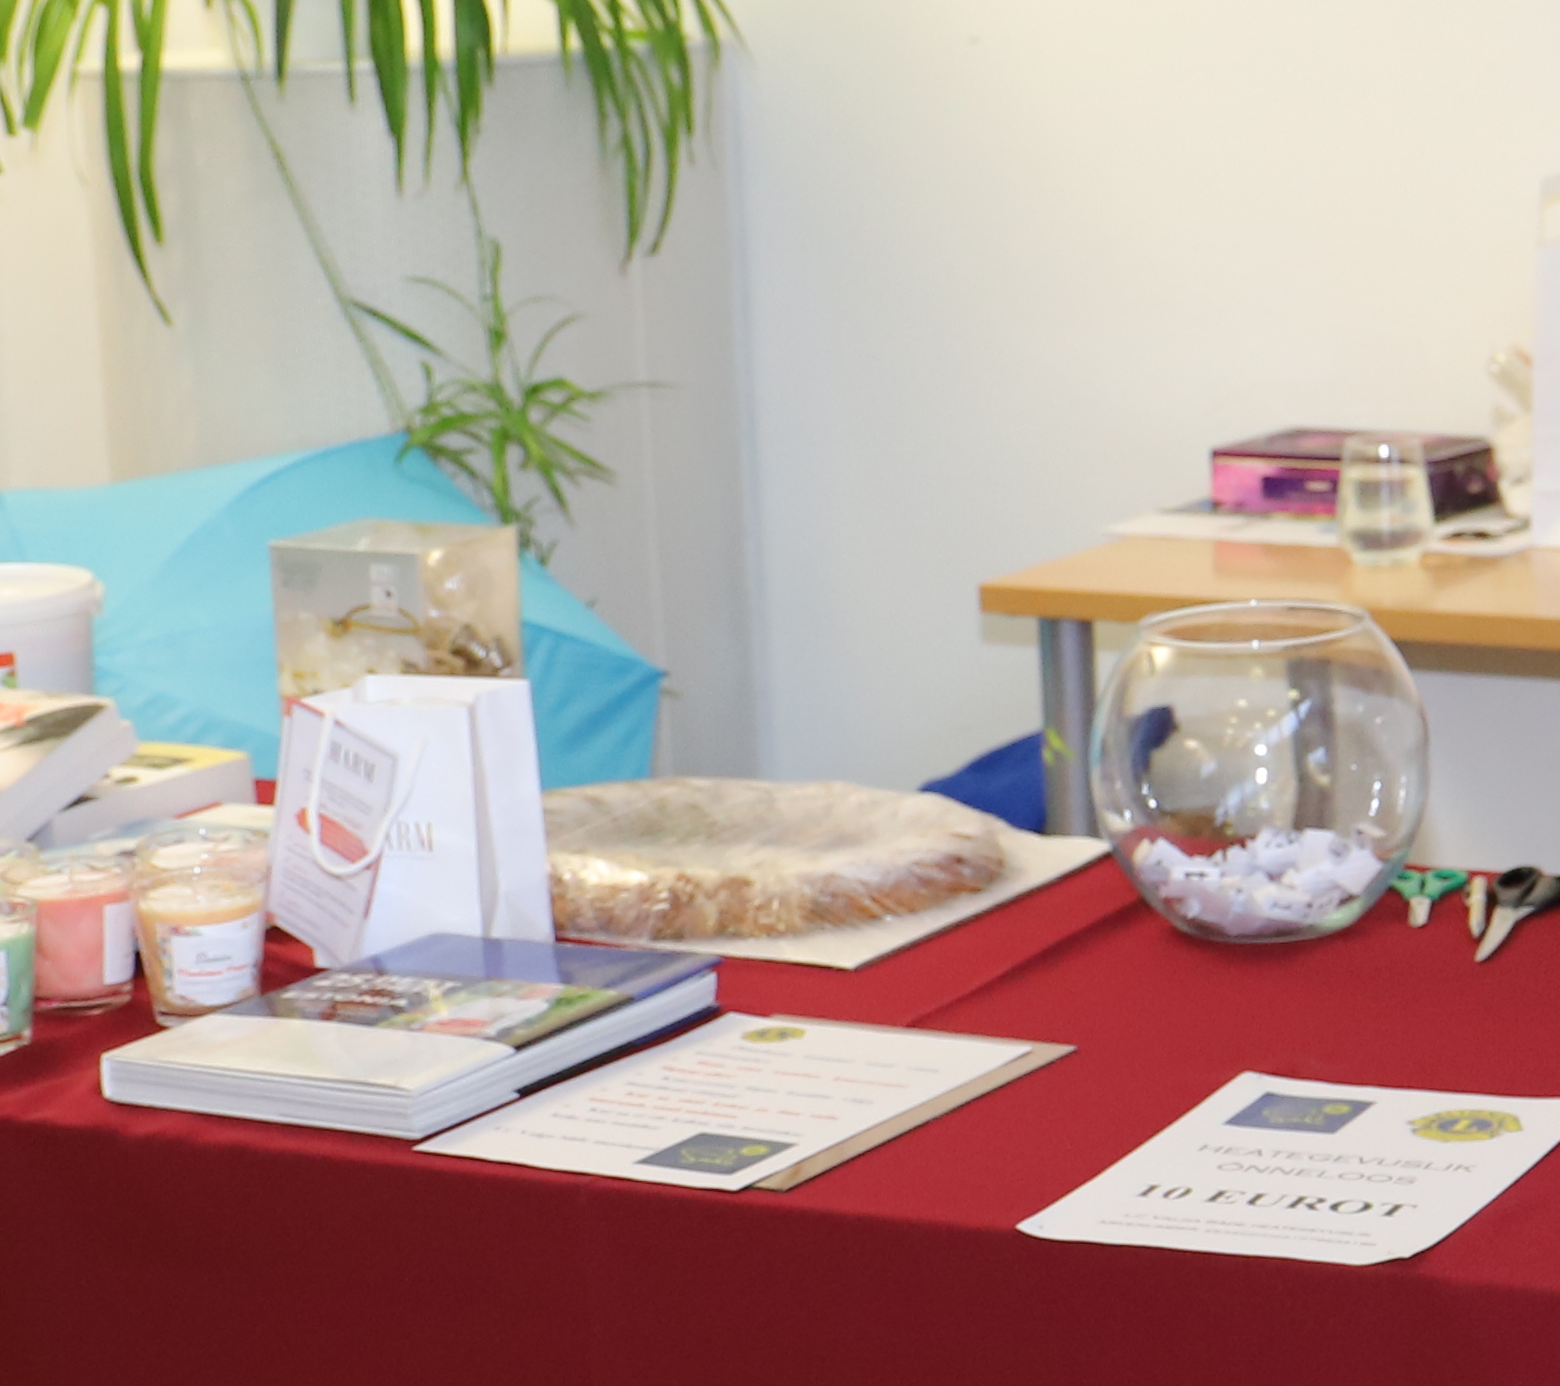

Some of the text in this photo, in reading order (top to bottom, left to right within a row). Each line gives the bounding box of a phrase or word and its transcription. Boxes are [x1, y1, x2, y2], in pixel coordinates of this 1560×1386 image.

[1197, 1143, 1478, 1174] HEATEGEVUSLIK
[1216, 1161, 1419, 1186] ÕNNELOOS
[1135, 1183, 1419, 1218] 10 EUROT
